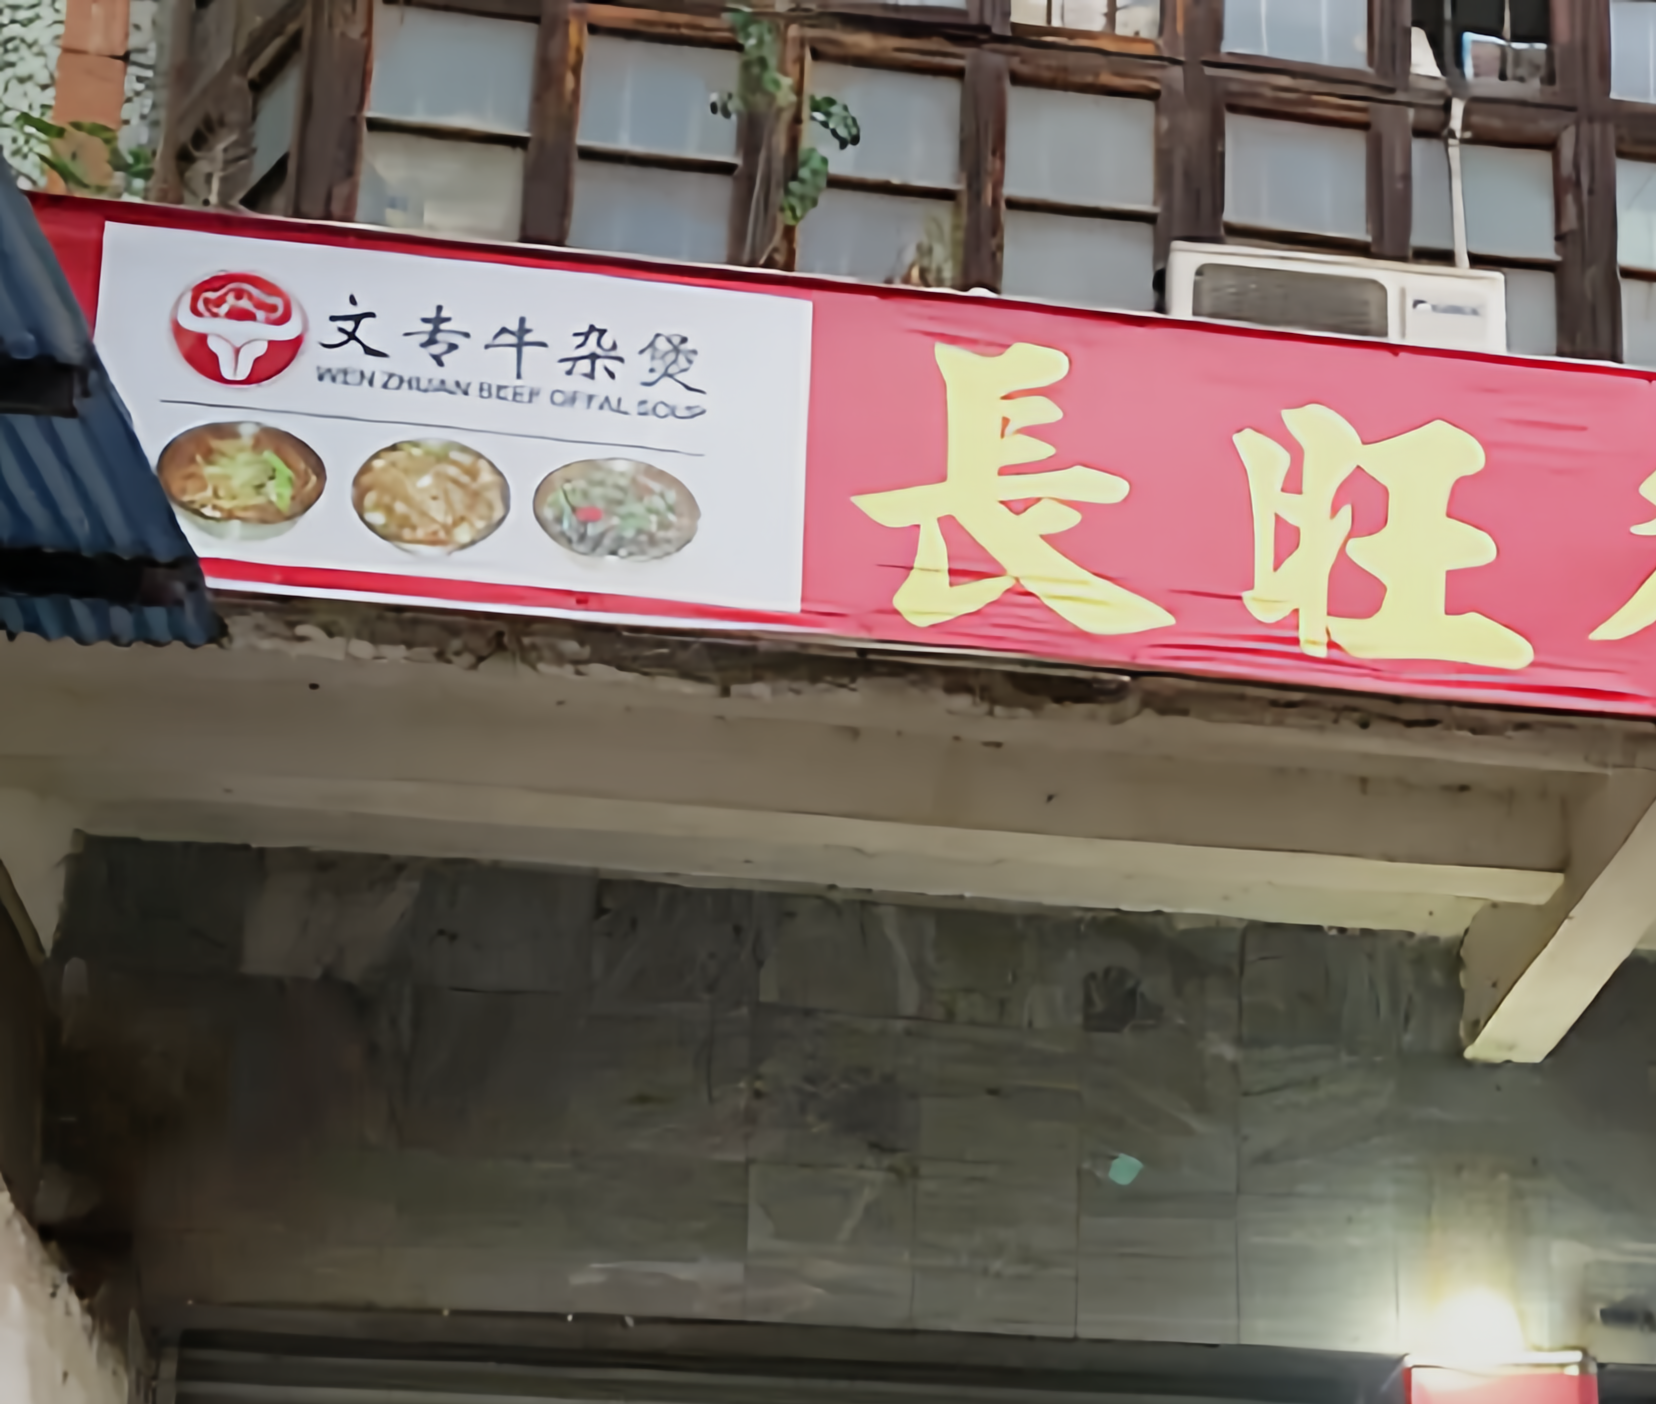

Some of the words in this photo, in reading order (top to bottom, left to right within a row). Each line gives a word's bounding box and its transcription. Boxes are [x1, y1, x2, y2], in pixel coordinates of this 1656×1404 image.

[318, 294, 707, 394] 文专牛杂煲
[316, 365, 375, 387] WEN
